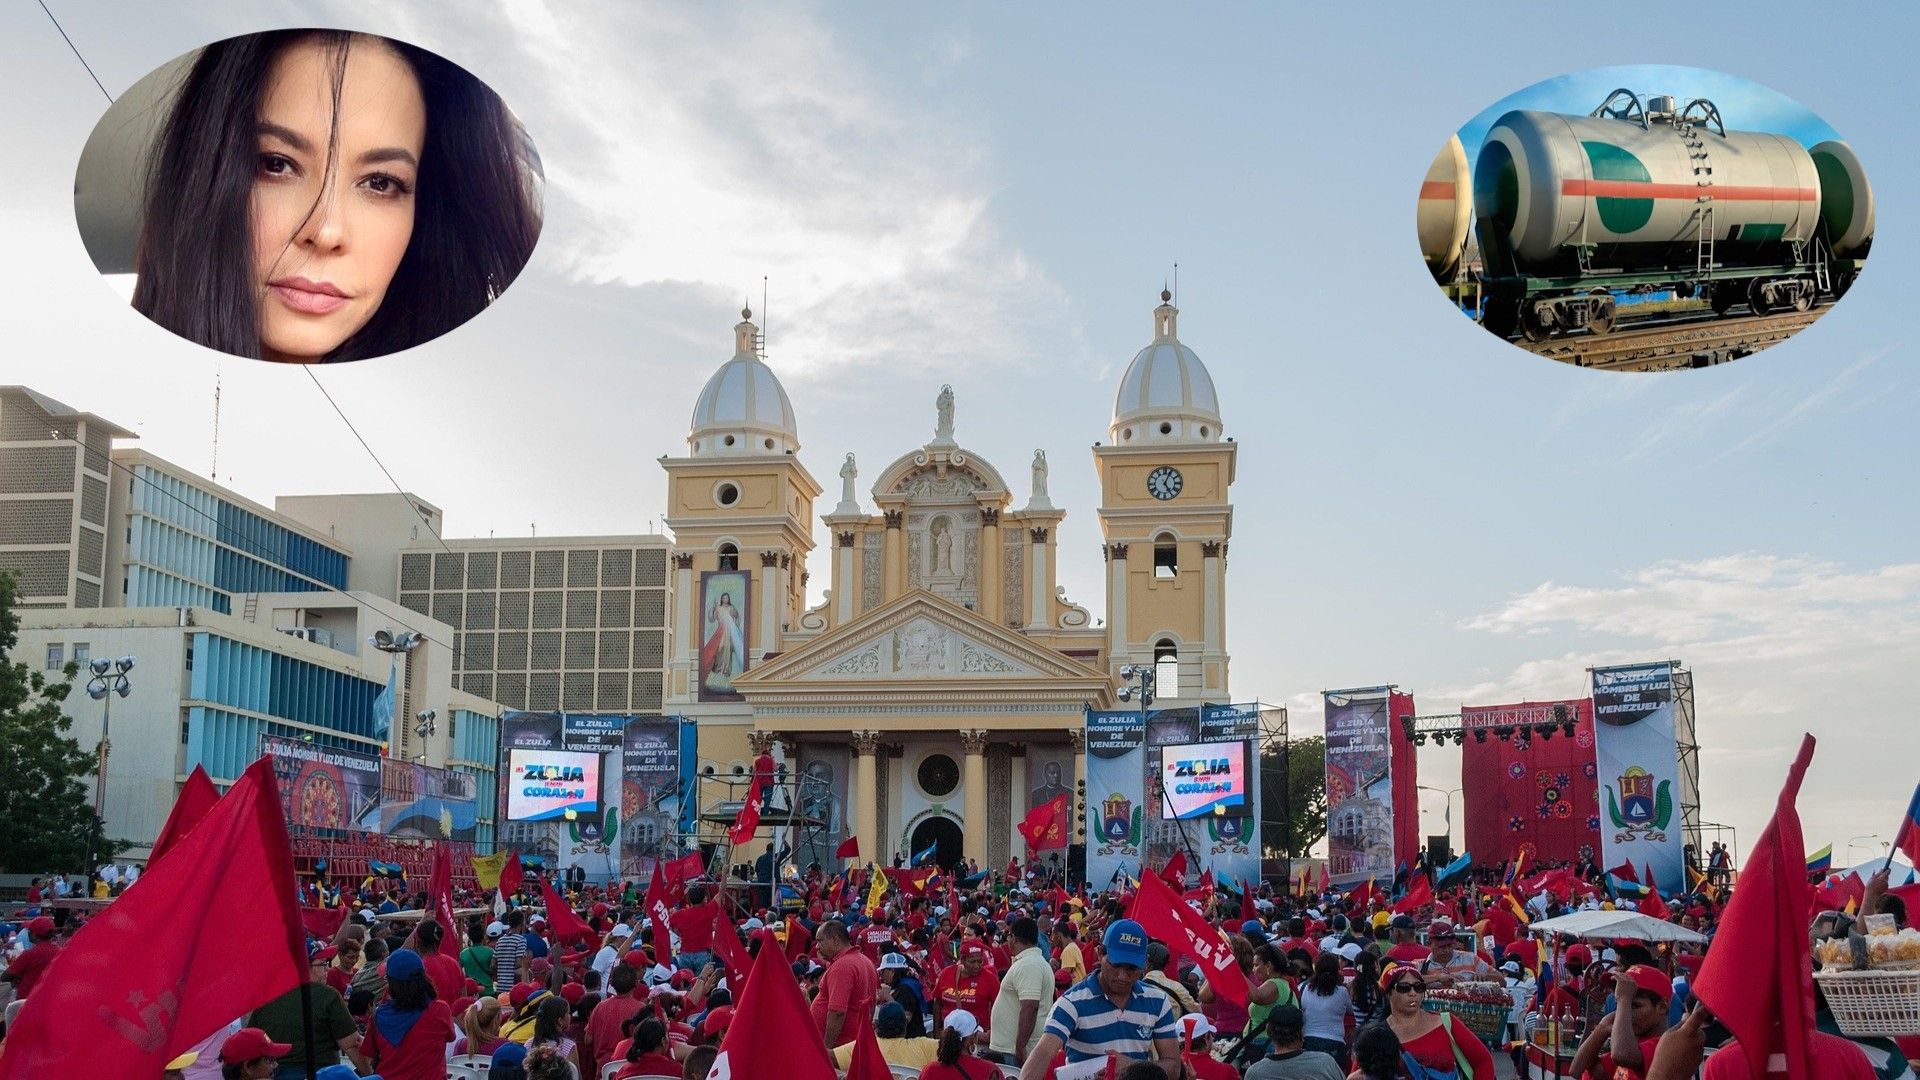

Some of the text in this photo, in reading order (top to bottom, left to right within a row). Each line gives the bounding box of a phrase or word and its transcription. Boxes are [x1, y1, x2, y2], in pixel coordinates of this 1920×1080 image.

[1594, 681, 1669, 695] NOMBRE Y LUZ
[1623, 693, 1641, 702] DE
[1598, 700, 1667, 714] VENEZUELA
[586, 720, 613, 728] ZULIA
[1347, 718, 1375, 727] ZULIA
[1222, 726, 1235, 734] DE
[1326, 728, 1362, 737] NOMBRE
[1369, 726, 1387, 734] LUZ
[1110, 732, 1124, 740] DE
[1167, 734, 1191, 742] ZULIA
[1349, 736, 1363, 744] DE
[567, 743, 621, 752] VENEZUELA
[644, 741, 669, 749] ZULIA
[1090, 740, 1144, 748] VENEZUELA
[1329, 743, 1385, 754] VENEZUELA
[291, 747, 318, 761] NOMBRE
[343, 757, 379, 773] VENEZUELA
[625, 764, 676, 772] VENEZUELA
[1175, 758, 1231, 777] ZULIA
[523, 764, 585, 782] ZULIA
